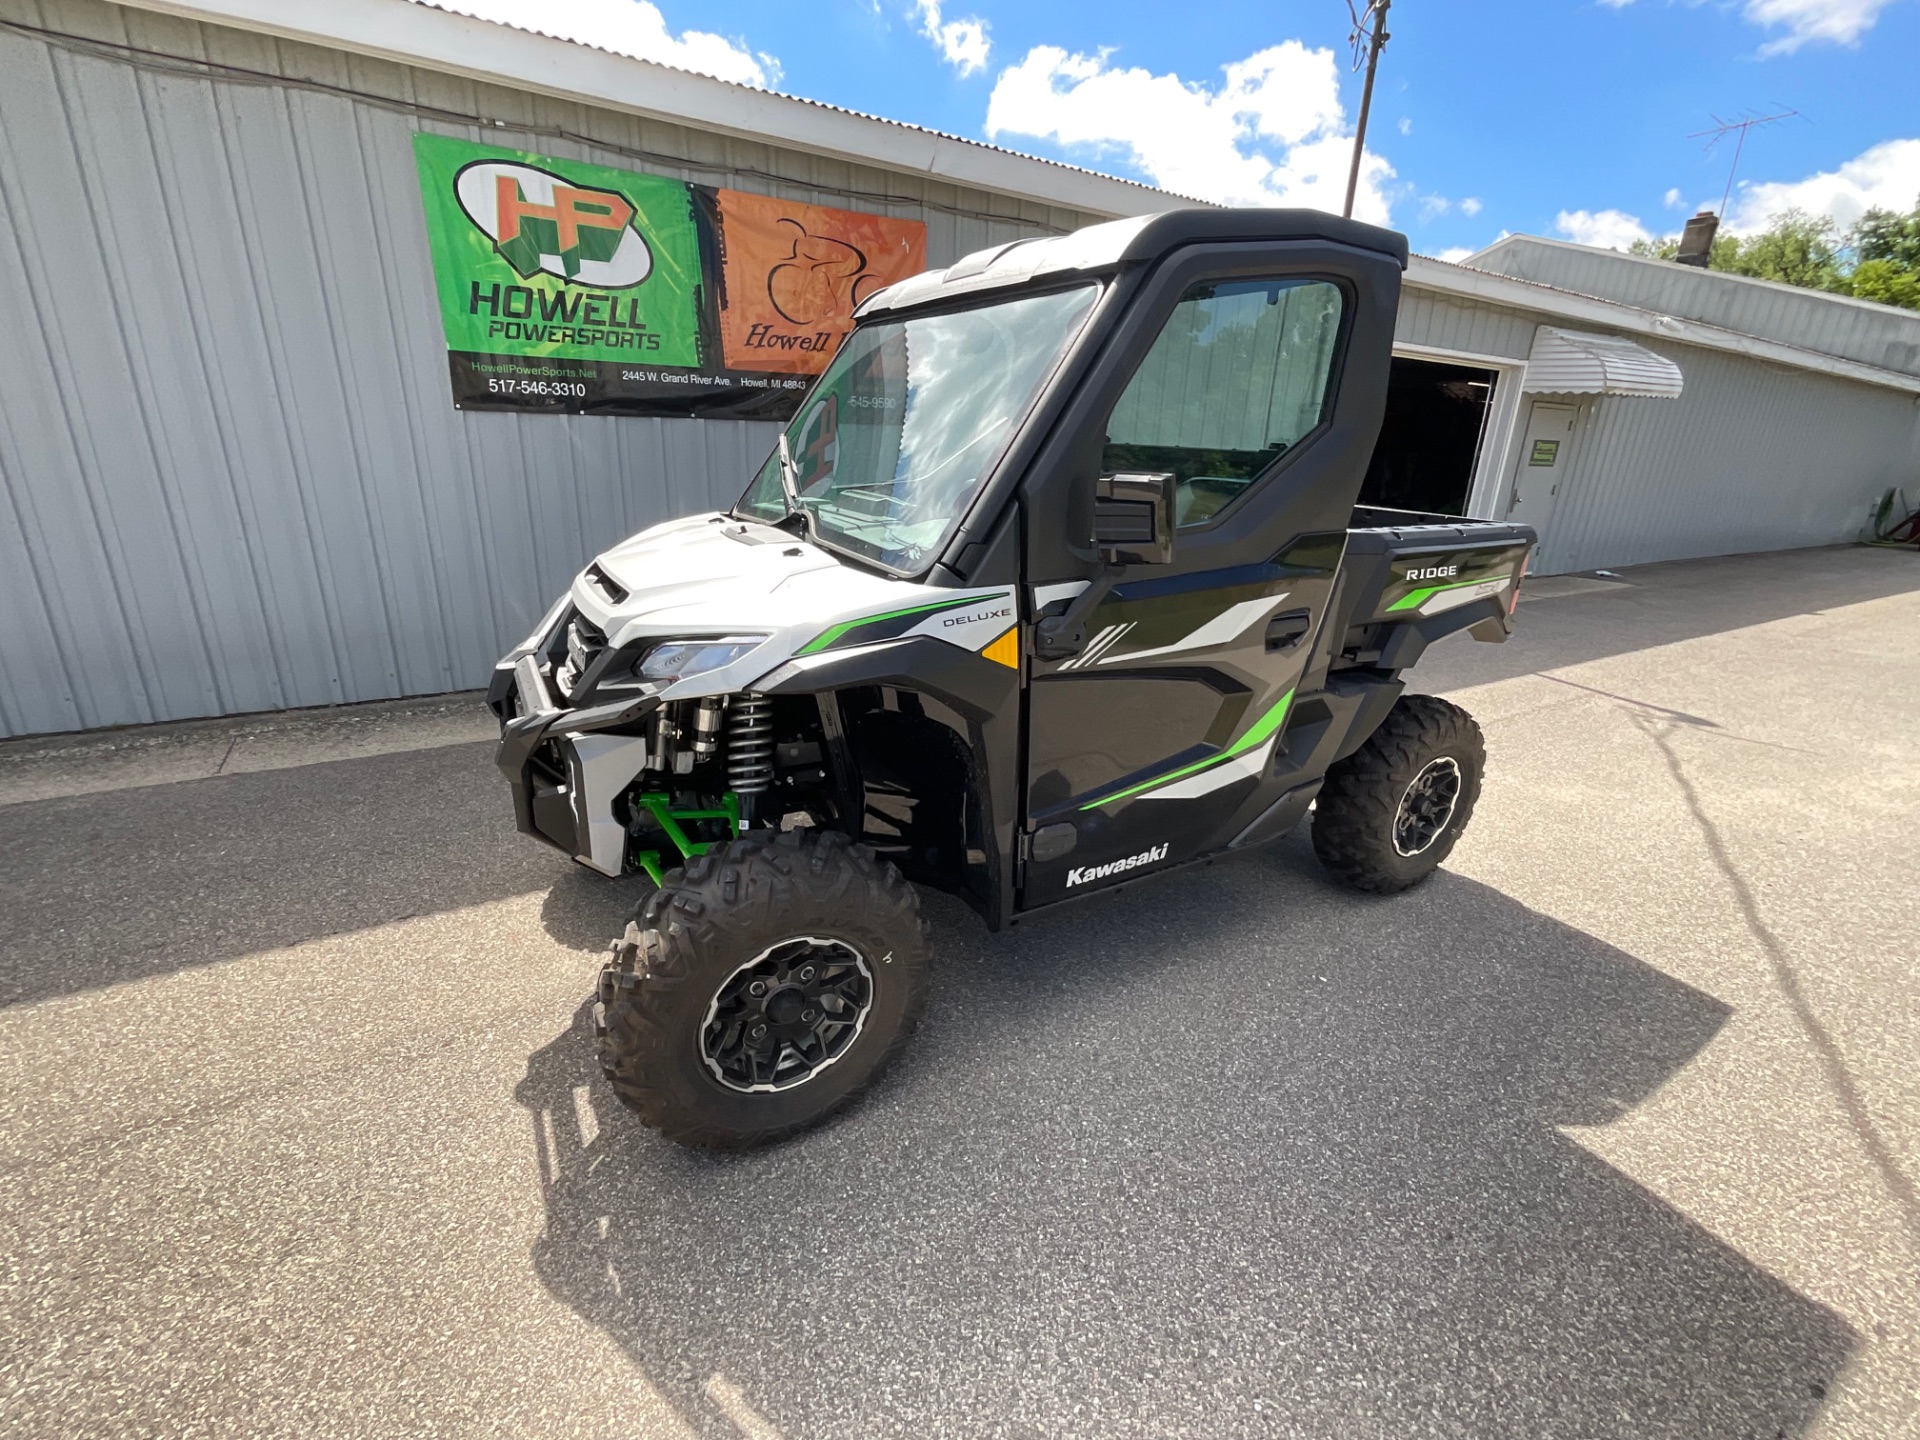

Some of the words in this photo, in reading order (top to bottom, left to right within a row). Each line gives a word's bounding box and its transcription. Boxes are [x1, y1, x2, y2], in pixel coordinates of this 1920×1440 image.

[496, 174, 635, 280] HP
[469, 280, 647, 330] HOWELL
[488, 320, 661, 351] POWERSPORTS
[744, 322, 832, 353] Howell
[471, 361, 598, 379] HowellPowerSports.Net
[622, 370, 645, 381] 2445
[647, 373, 659, 382] W.
[661, 374, 689, 384] Grand
[691, 375, 712, 386] River
[714, 376, 732, 386] Ave.
[741, 377, 770, 389] Howell,
[771, 380, 781, 389] MI
[782, 380, 806, 390] 48843
[488, 379, 586, 397] 517-546-3310
[1406, 565, 1457, 581] RIDGE
[943, 608, 1012, 627] DELUXE
[1066, 842, 1169, 888] Kawasaki
